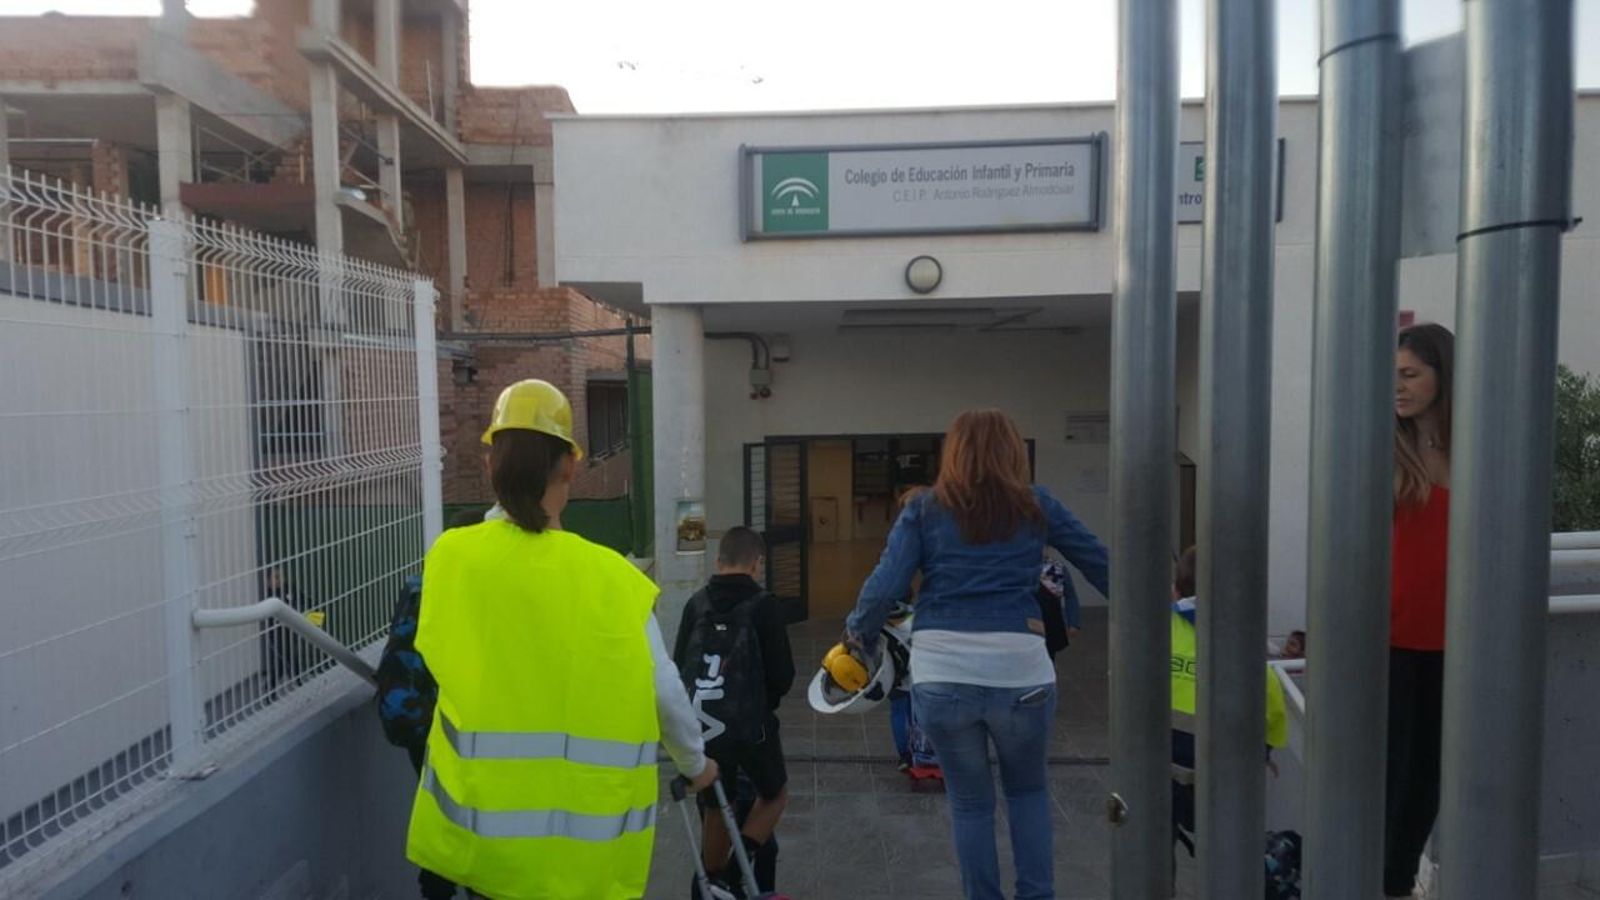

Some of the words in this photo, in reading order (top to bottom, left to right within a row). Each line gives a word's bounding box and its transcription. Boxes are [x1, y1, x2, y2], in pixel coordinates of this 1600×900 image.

[844, 167, 888, 187] Colegio
[890, 167, 905, 183] de
[908, 164, 968, 183] Educación
[972, 163, 1011, 181] Infantil
[1014, 167, 1022, 183] y
[1024, 161, 1075, 179] Primaria
[692, 653, 727, 743] FILA
